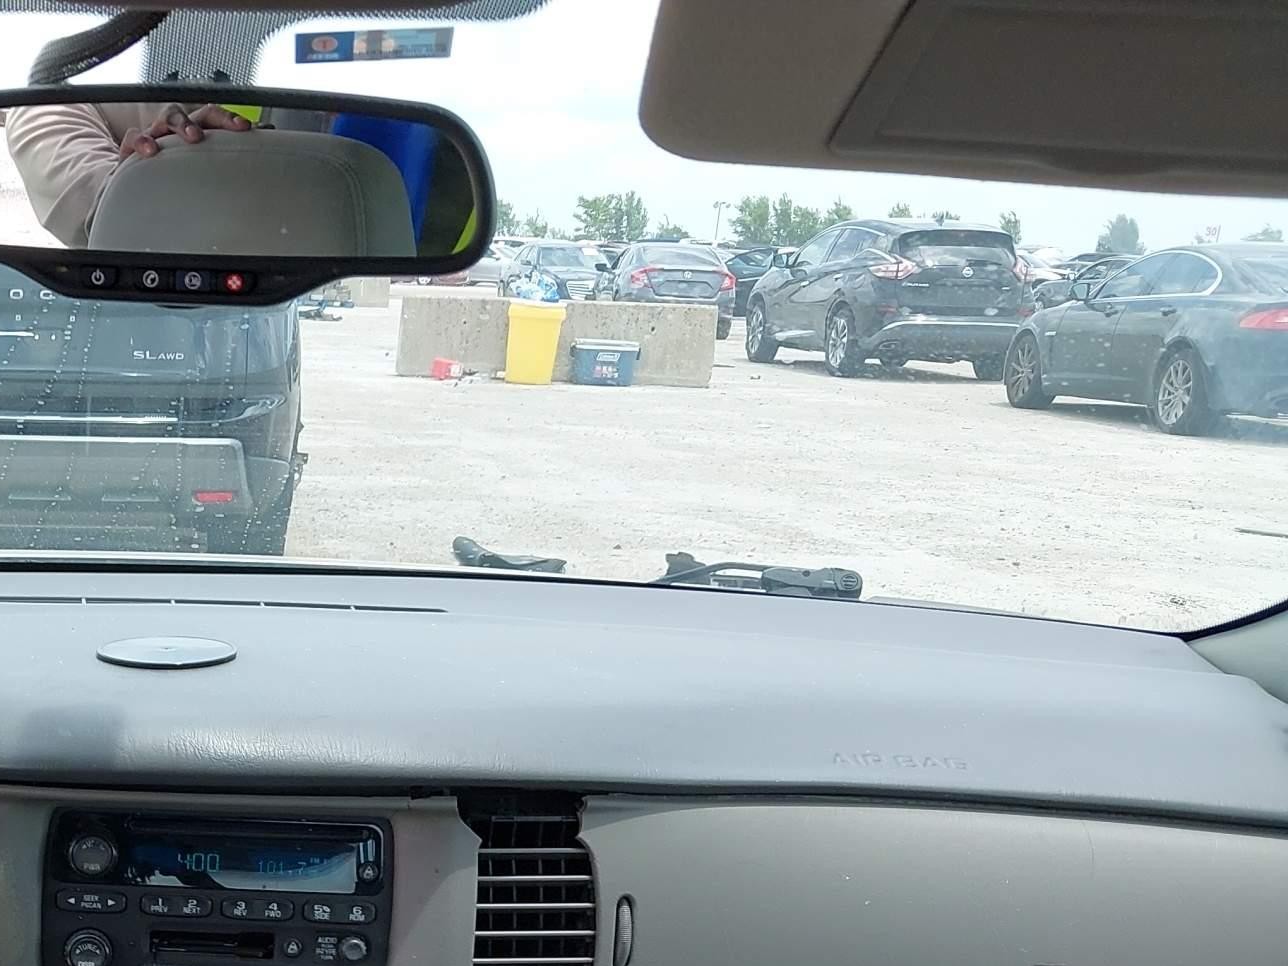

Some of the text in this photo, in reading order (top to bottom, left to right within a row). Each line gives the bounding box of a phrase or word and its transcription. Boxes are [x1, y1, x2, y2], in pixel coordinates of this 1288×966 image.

[157, 897, 163, 907] 1
[188, 899, 198, 908] 2
[236, 901, 246, 910] 3
[268, 902, 278, 911] 4
[313, 904, 323, 913] 5
[352, 906, 363, 915] 6
